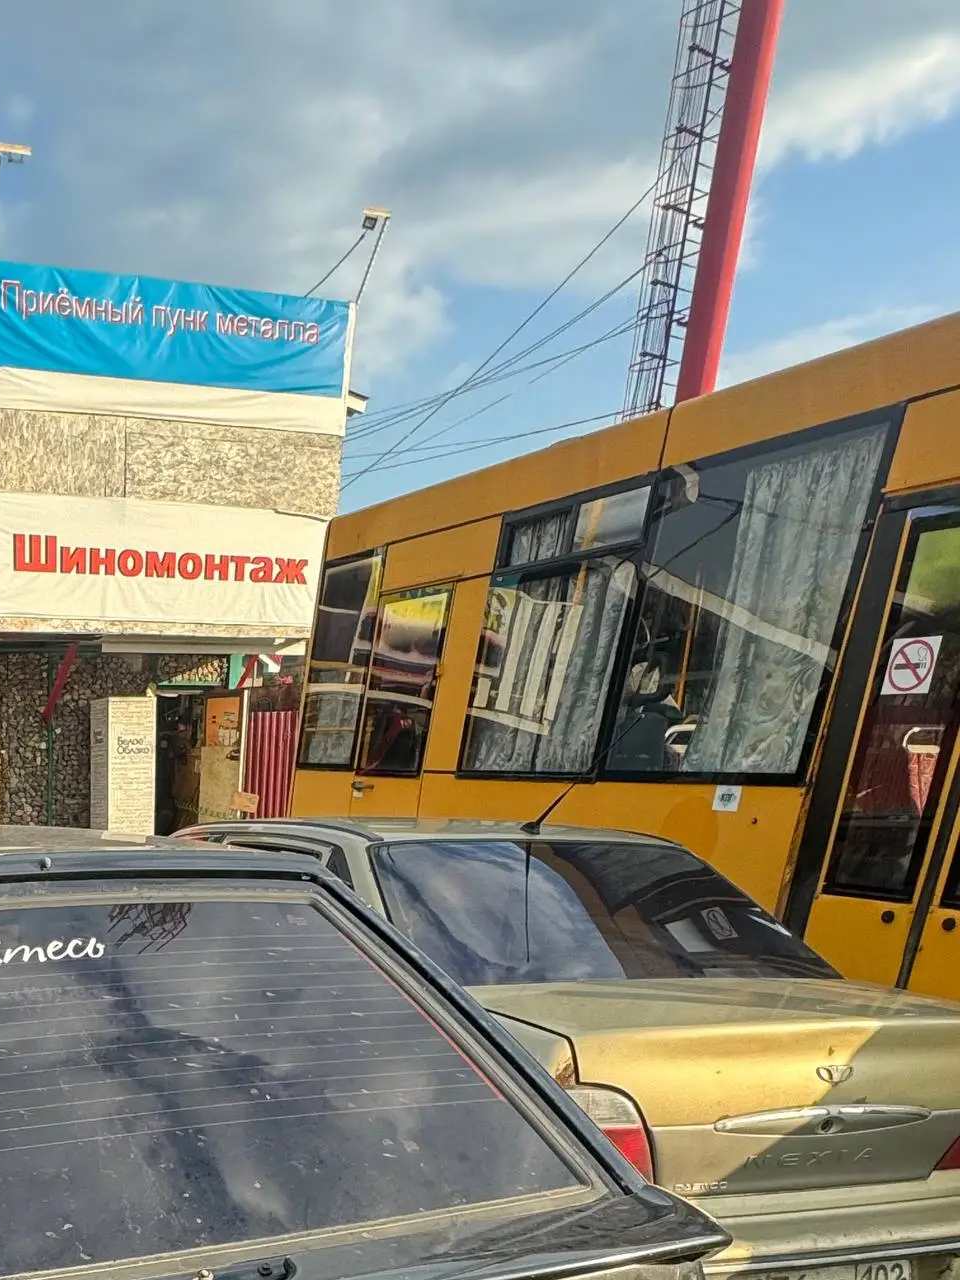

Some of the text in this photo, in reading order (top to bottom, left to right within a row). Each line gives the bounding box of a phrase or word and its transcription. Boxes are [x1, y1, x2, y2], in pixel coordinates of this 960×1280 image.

[1, 279, 320, 344] Приёмный пунк металла
[12, 533, 309, 585] Шиномонтаж
